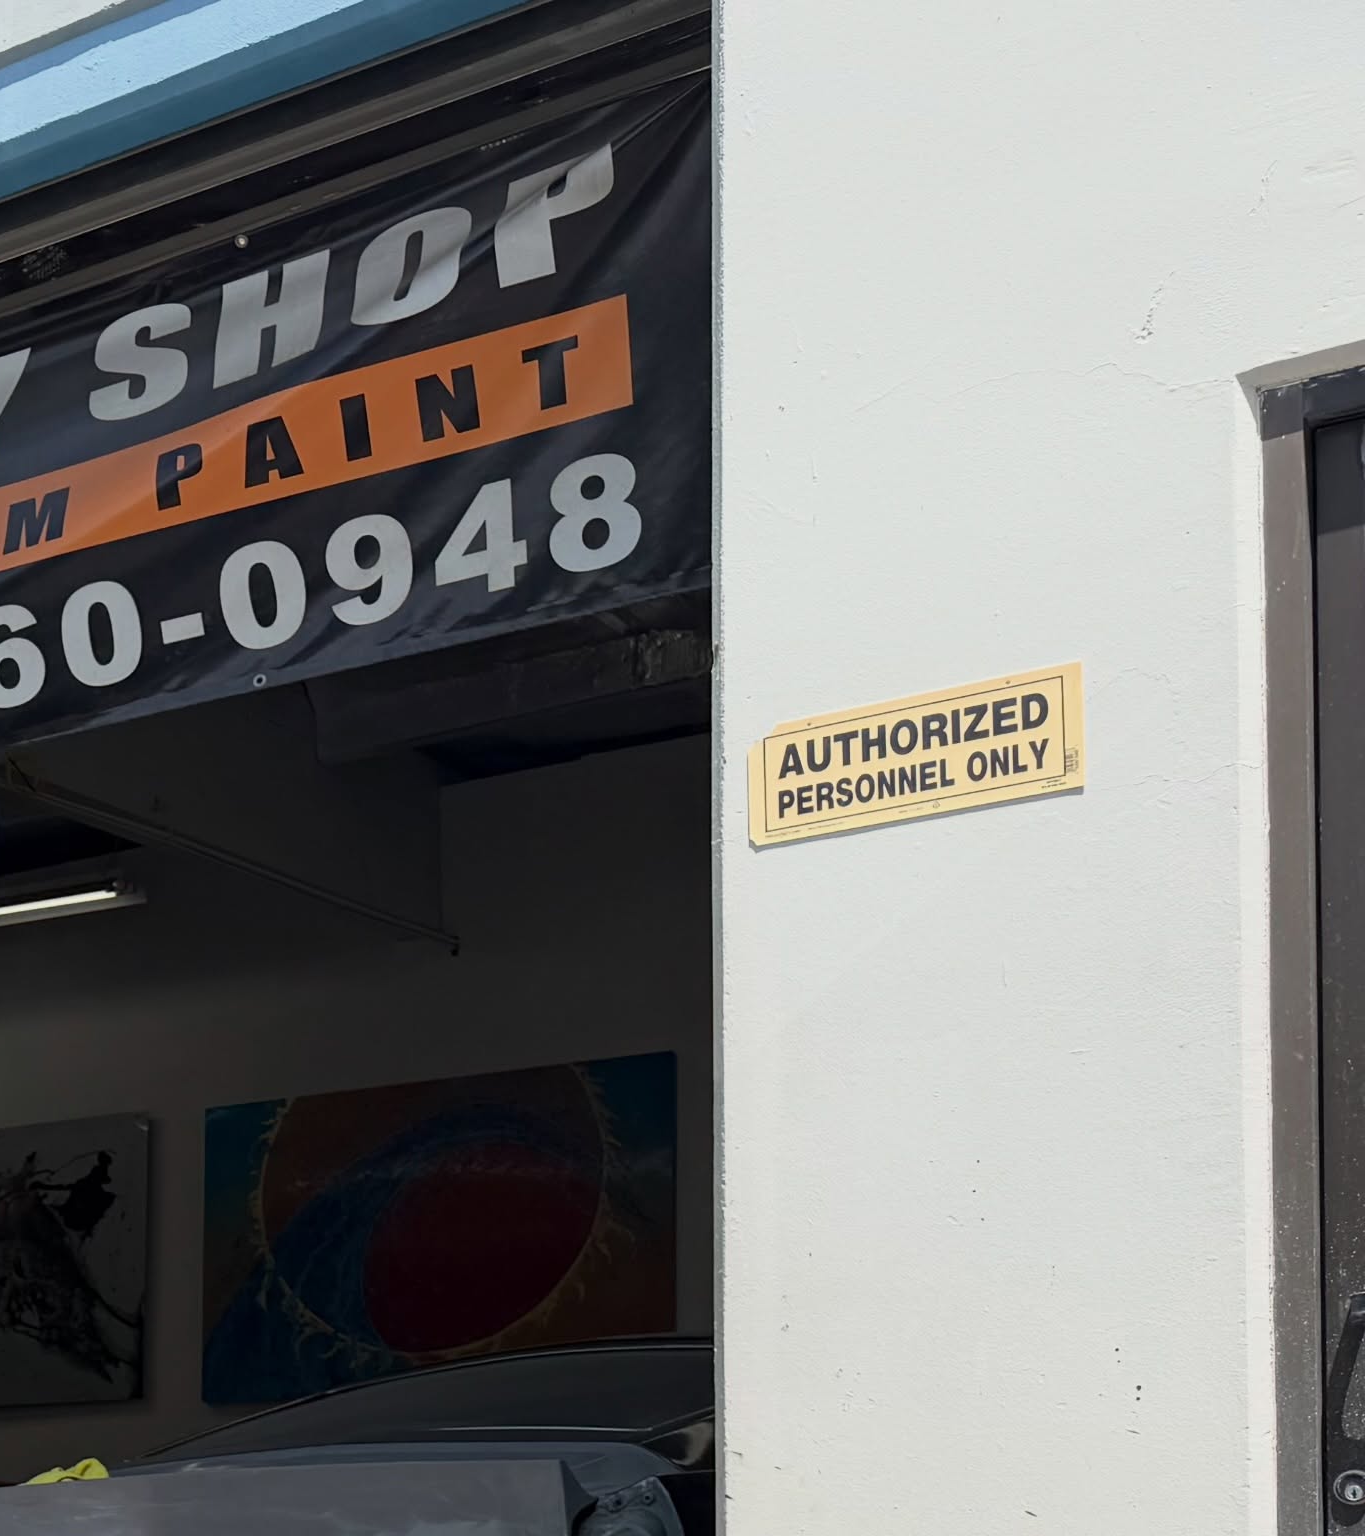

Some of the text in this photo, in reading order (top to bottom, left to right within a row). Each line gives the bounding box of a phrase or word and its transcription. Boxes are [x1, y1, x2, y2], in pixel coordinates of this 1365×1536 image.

[88, 142, 616, 422] SHOP
[155, 334, 579, 511] PAINT
[778, 692, 1049, 779] AUTHORIZED
[778, 758, 955, 819] PERSONNEL
[966, 738, 1050, 782] ONLY
